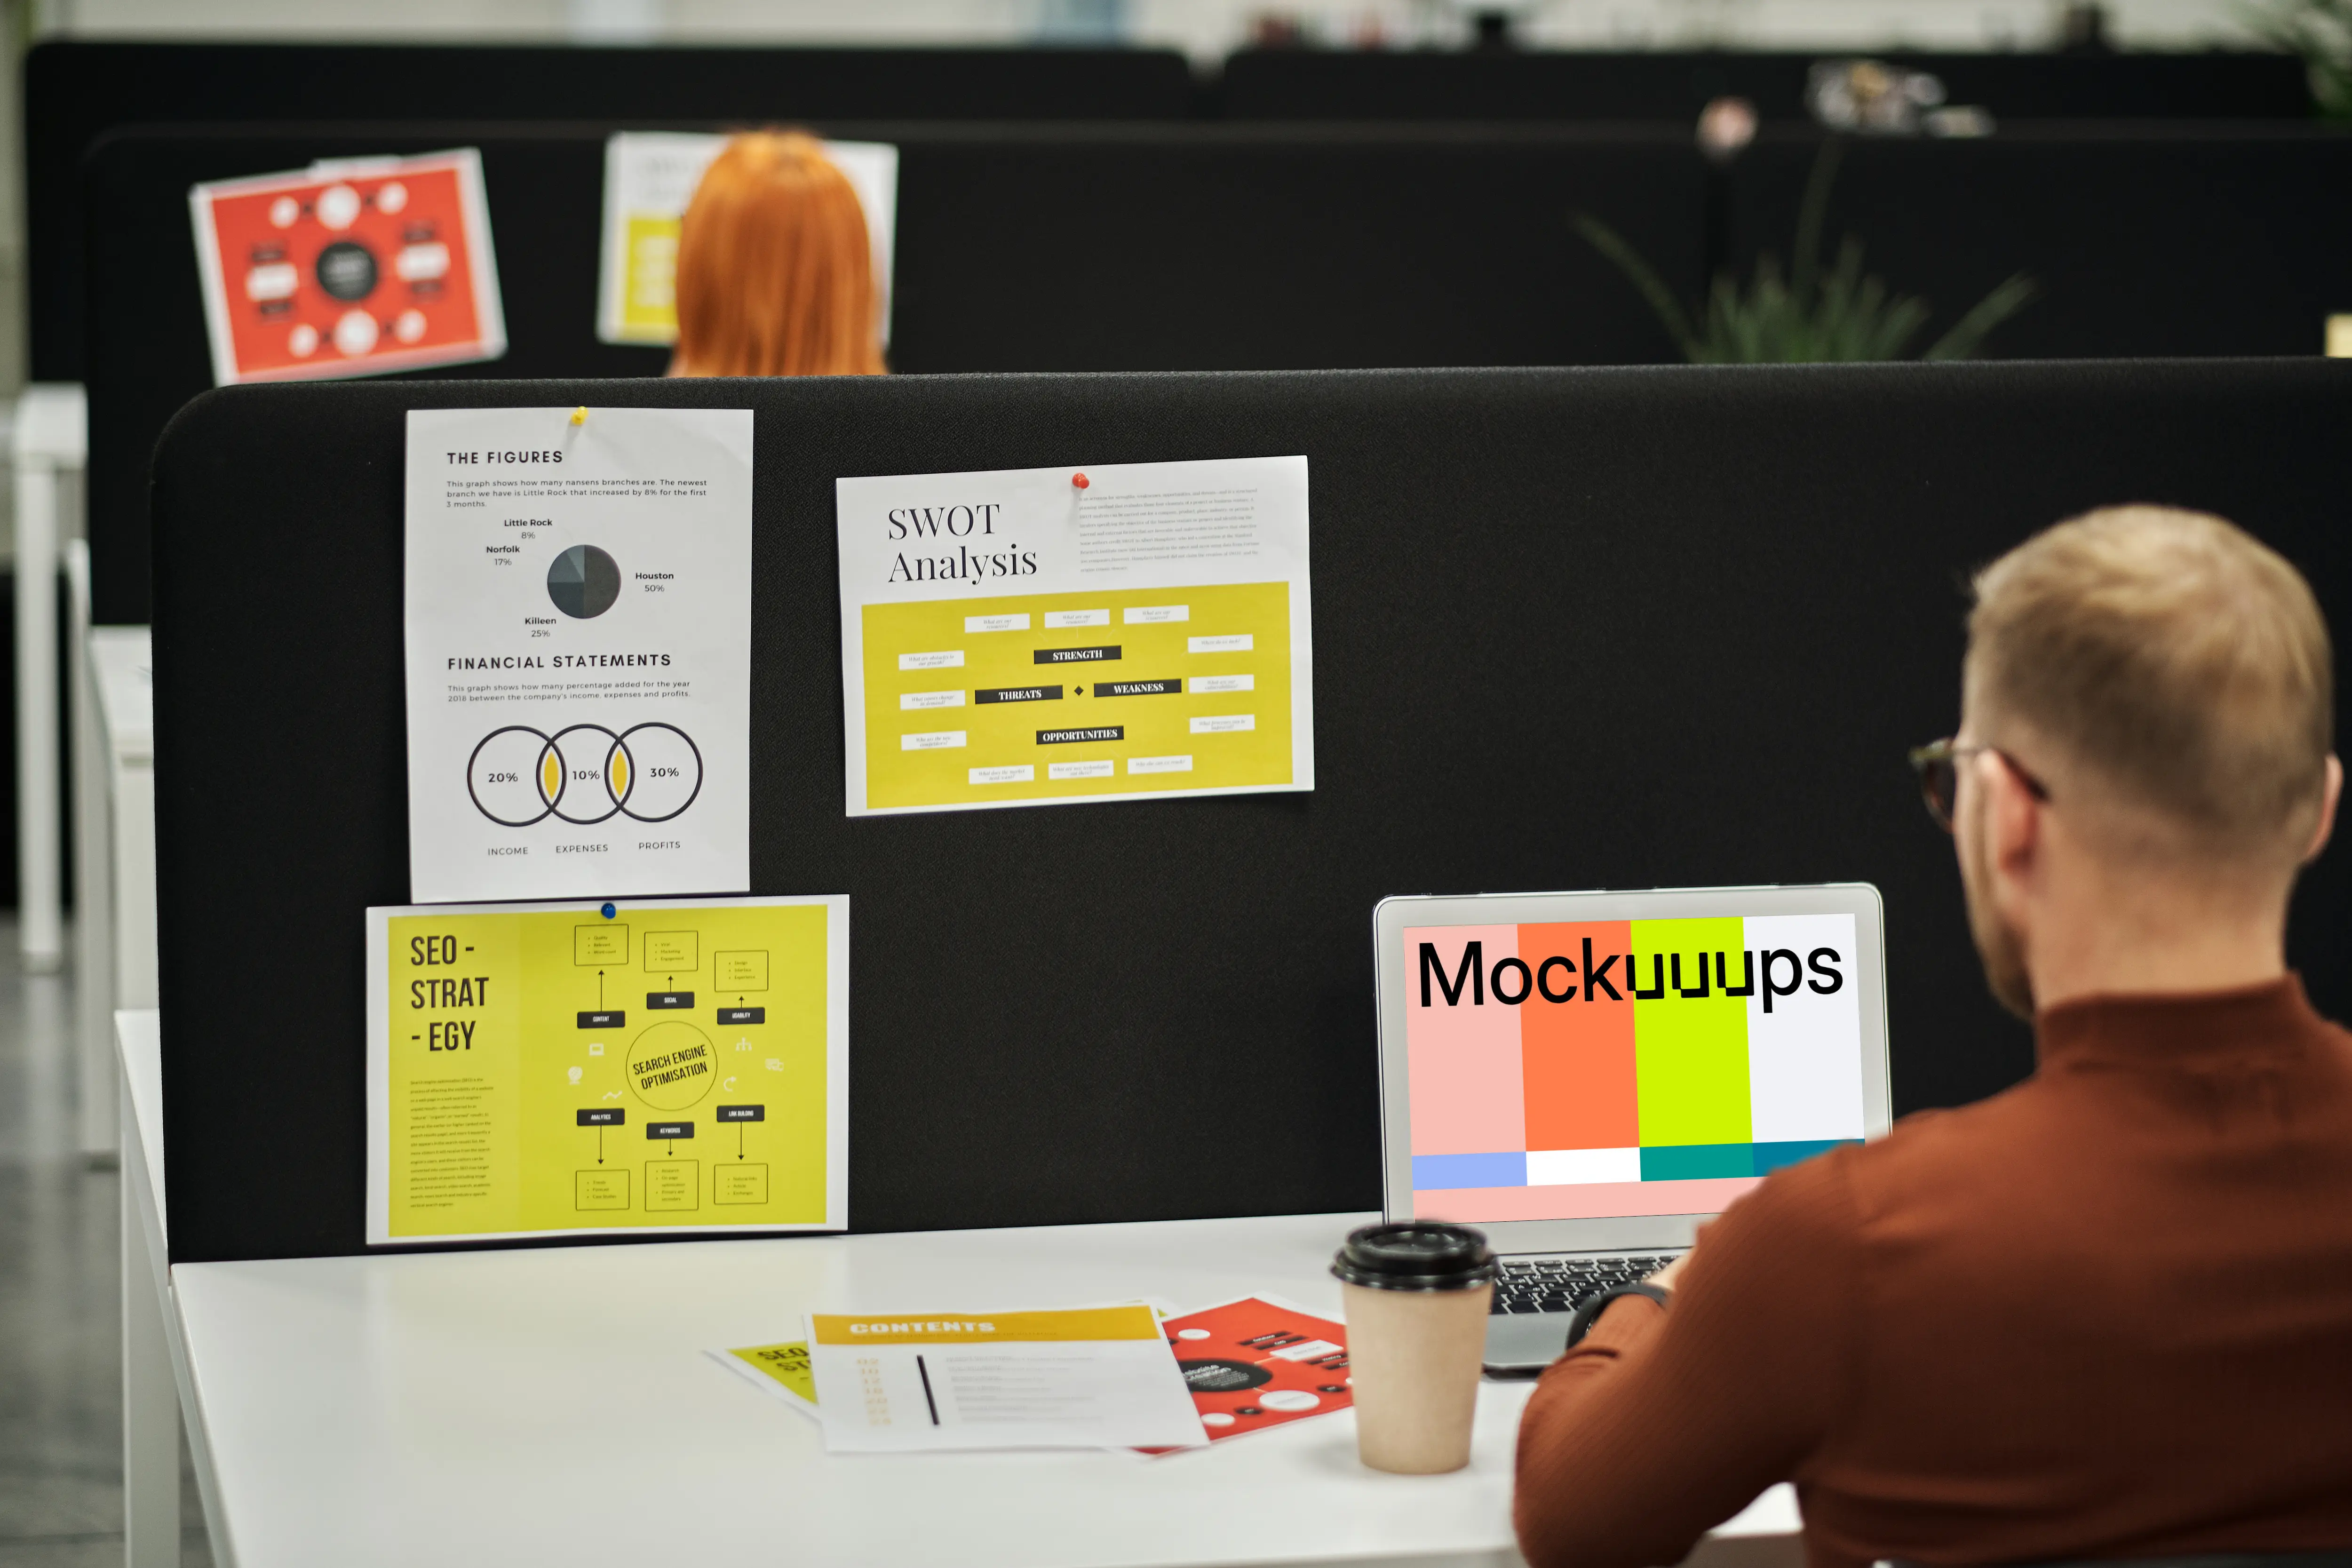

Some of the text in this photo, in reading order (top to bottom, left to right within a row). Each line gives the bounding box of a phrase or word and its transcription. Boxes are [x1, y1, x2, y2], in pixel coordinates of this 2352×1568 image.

[447, 451, 562, 464] THE FIGURES
[888, 503, 1001, 540] SWOT
[888, 543, 1037, 585] Analysis
[1053, 649, 1102, 660] STRENGTH
[448, 654, 670, 669] FINANCIAL STATEMENTS
[998, 689, 1041, 701] THREATS
[1113, 683, 1164, 694] WEAKNESS
[1042, 729, 1117, 741] OPPORTUNITIES
[488, 772, 518, 782] 20%
[572, 770, 600, 780] 10%
[650, 767, 679, 777] 30%
[488, 847, 528, 855] INCOME
[556, 844, 608, 853] EXPENSES
[411, 935, 457, 965] SEO
[1419, 937, 1843, 1013] Mockuuups
[411, 977, 489, 1009] STRAT
[429, 1020, 476, 1051] EGY
[633, 1044, 707, 1075] SEARCH ENGINE
[641, 1061, 708, 1090] OPTIMISATION
[850, 1321, 995, 1334] CONTENTS
[757, 1347, 809, 1360] SEO
[776, 1360, 811, 1371] ST
